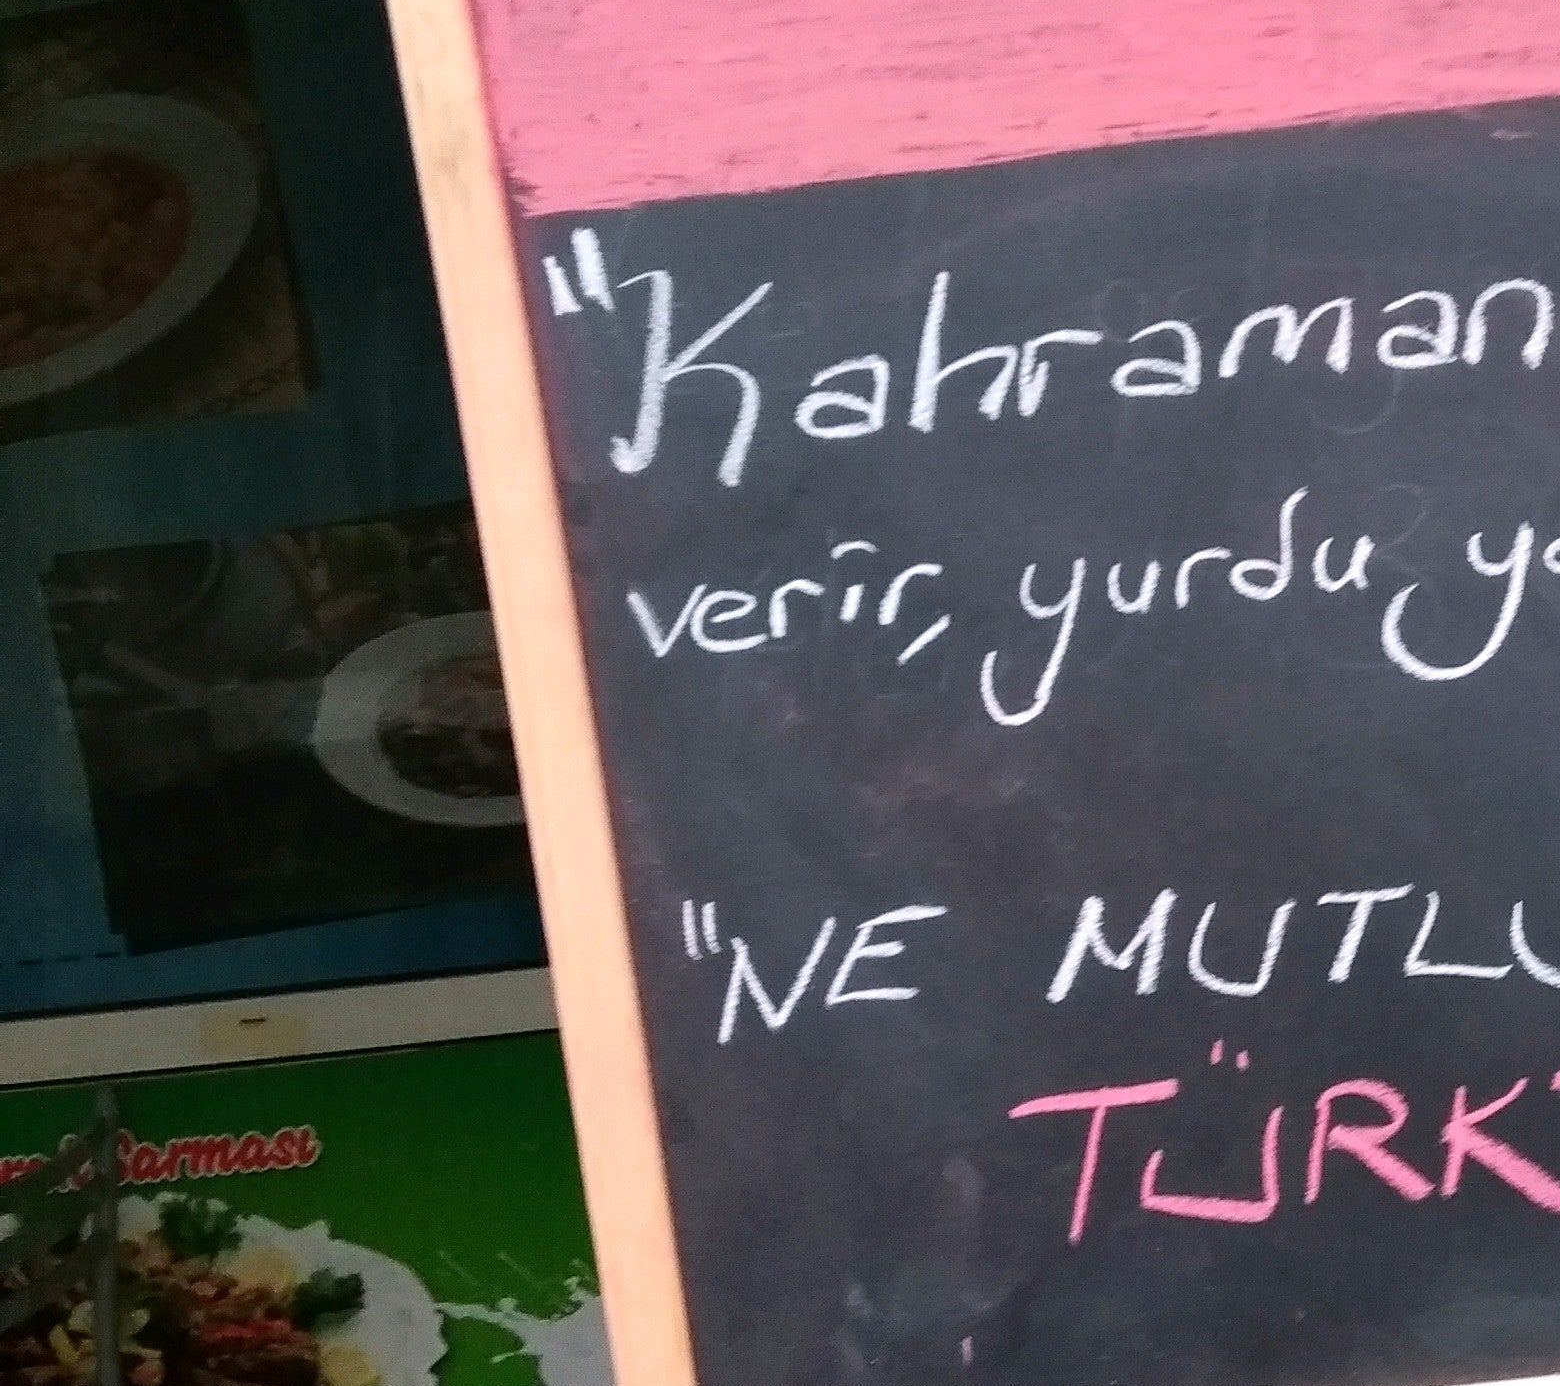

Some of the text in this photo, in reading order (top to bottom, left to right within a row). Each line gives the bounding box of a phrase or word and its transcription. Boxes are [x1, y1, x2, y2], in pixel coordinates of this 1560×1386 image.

[626, 540, 952, 666] verir,
[980, 486, 1374, 727] yurdu
[681, 899, 948, 1044] "NE
